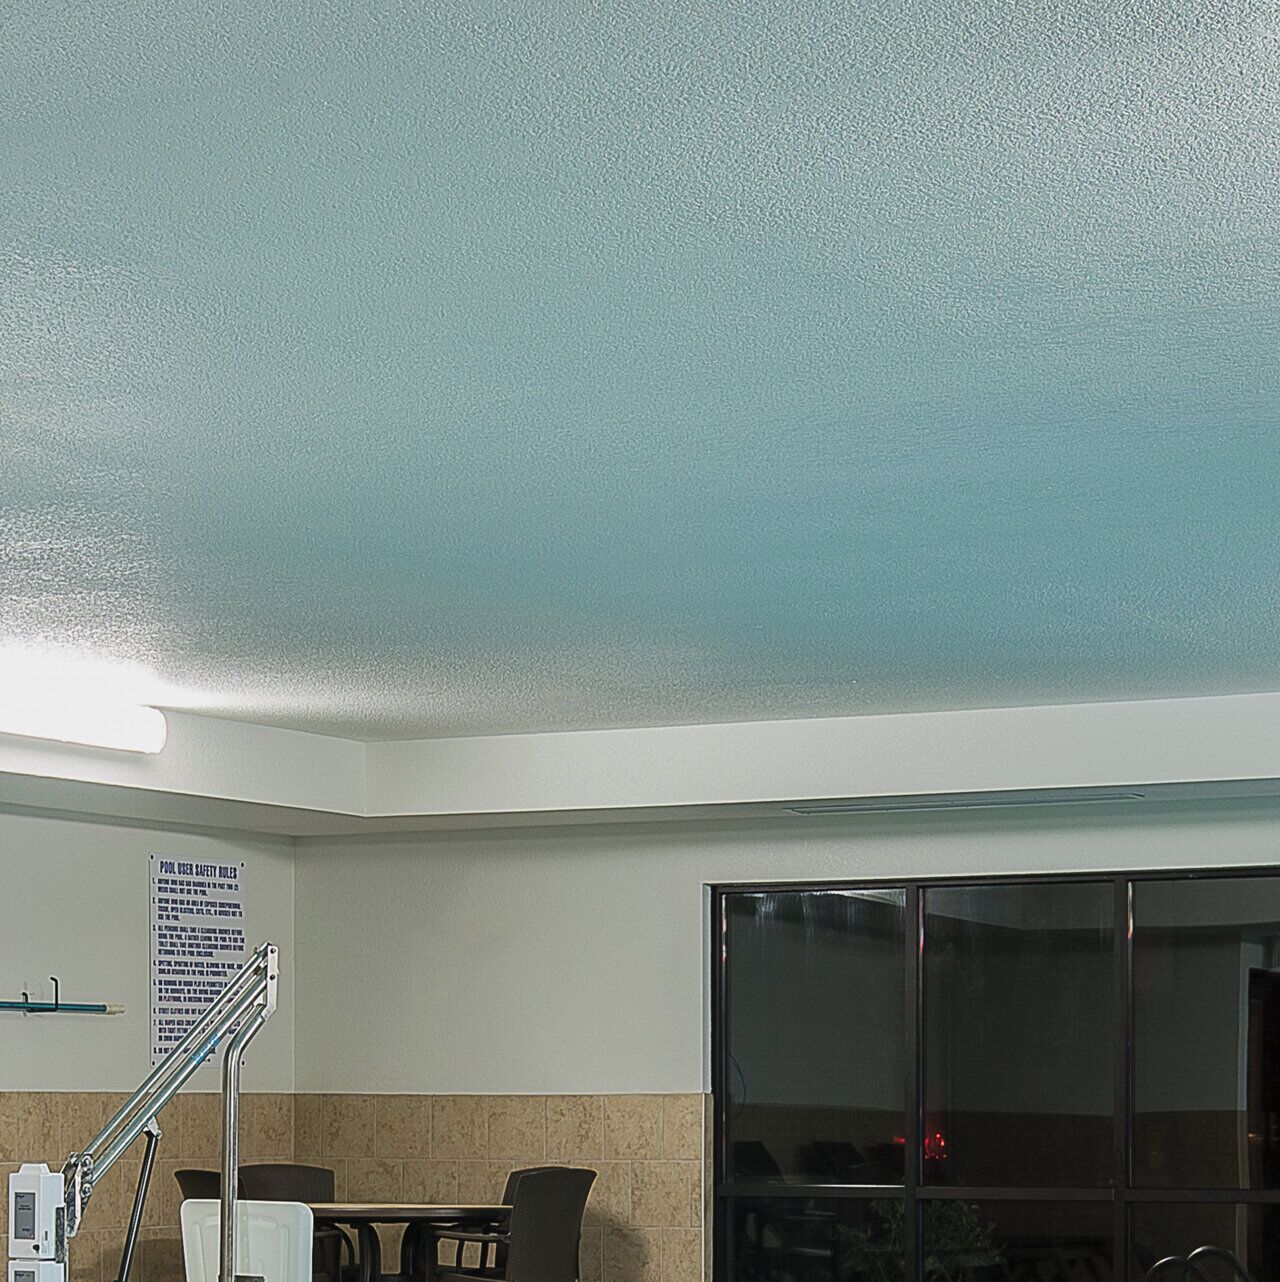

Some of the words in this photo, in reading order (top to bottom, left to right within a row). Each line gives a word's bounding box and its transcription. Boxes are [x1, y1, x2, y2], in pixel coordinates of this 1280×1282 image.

[160, 861, 176, 875] POOL
[178, 862, 193, 876] USER
[195, 863, 217, 878] SAFETY
[219, 865, 237, 880] RULES
